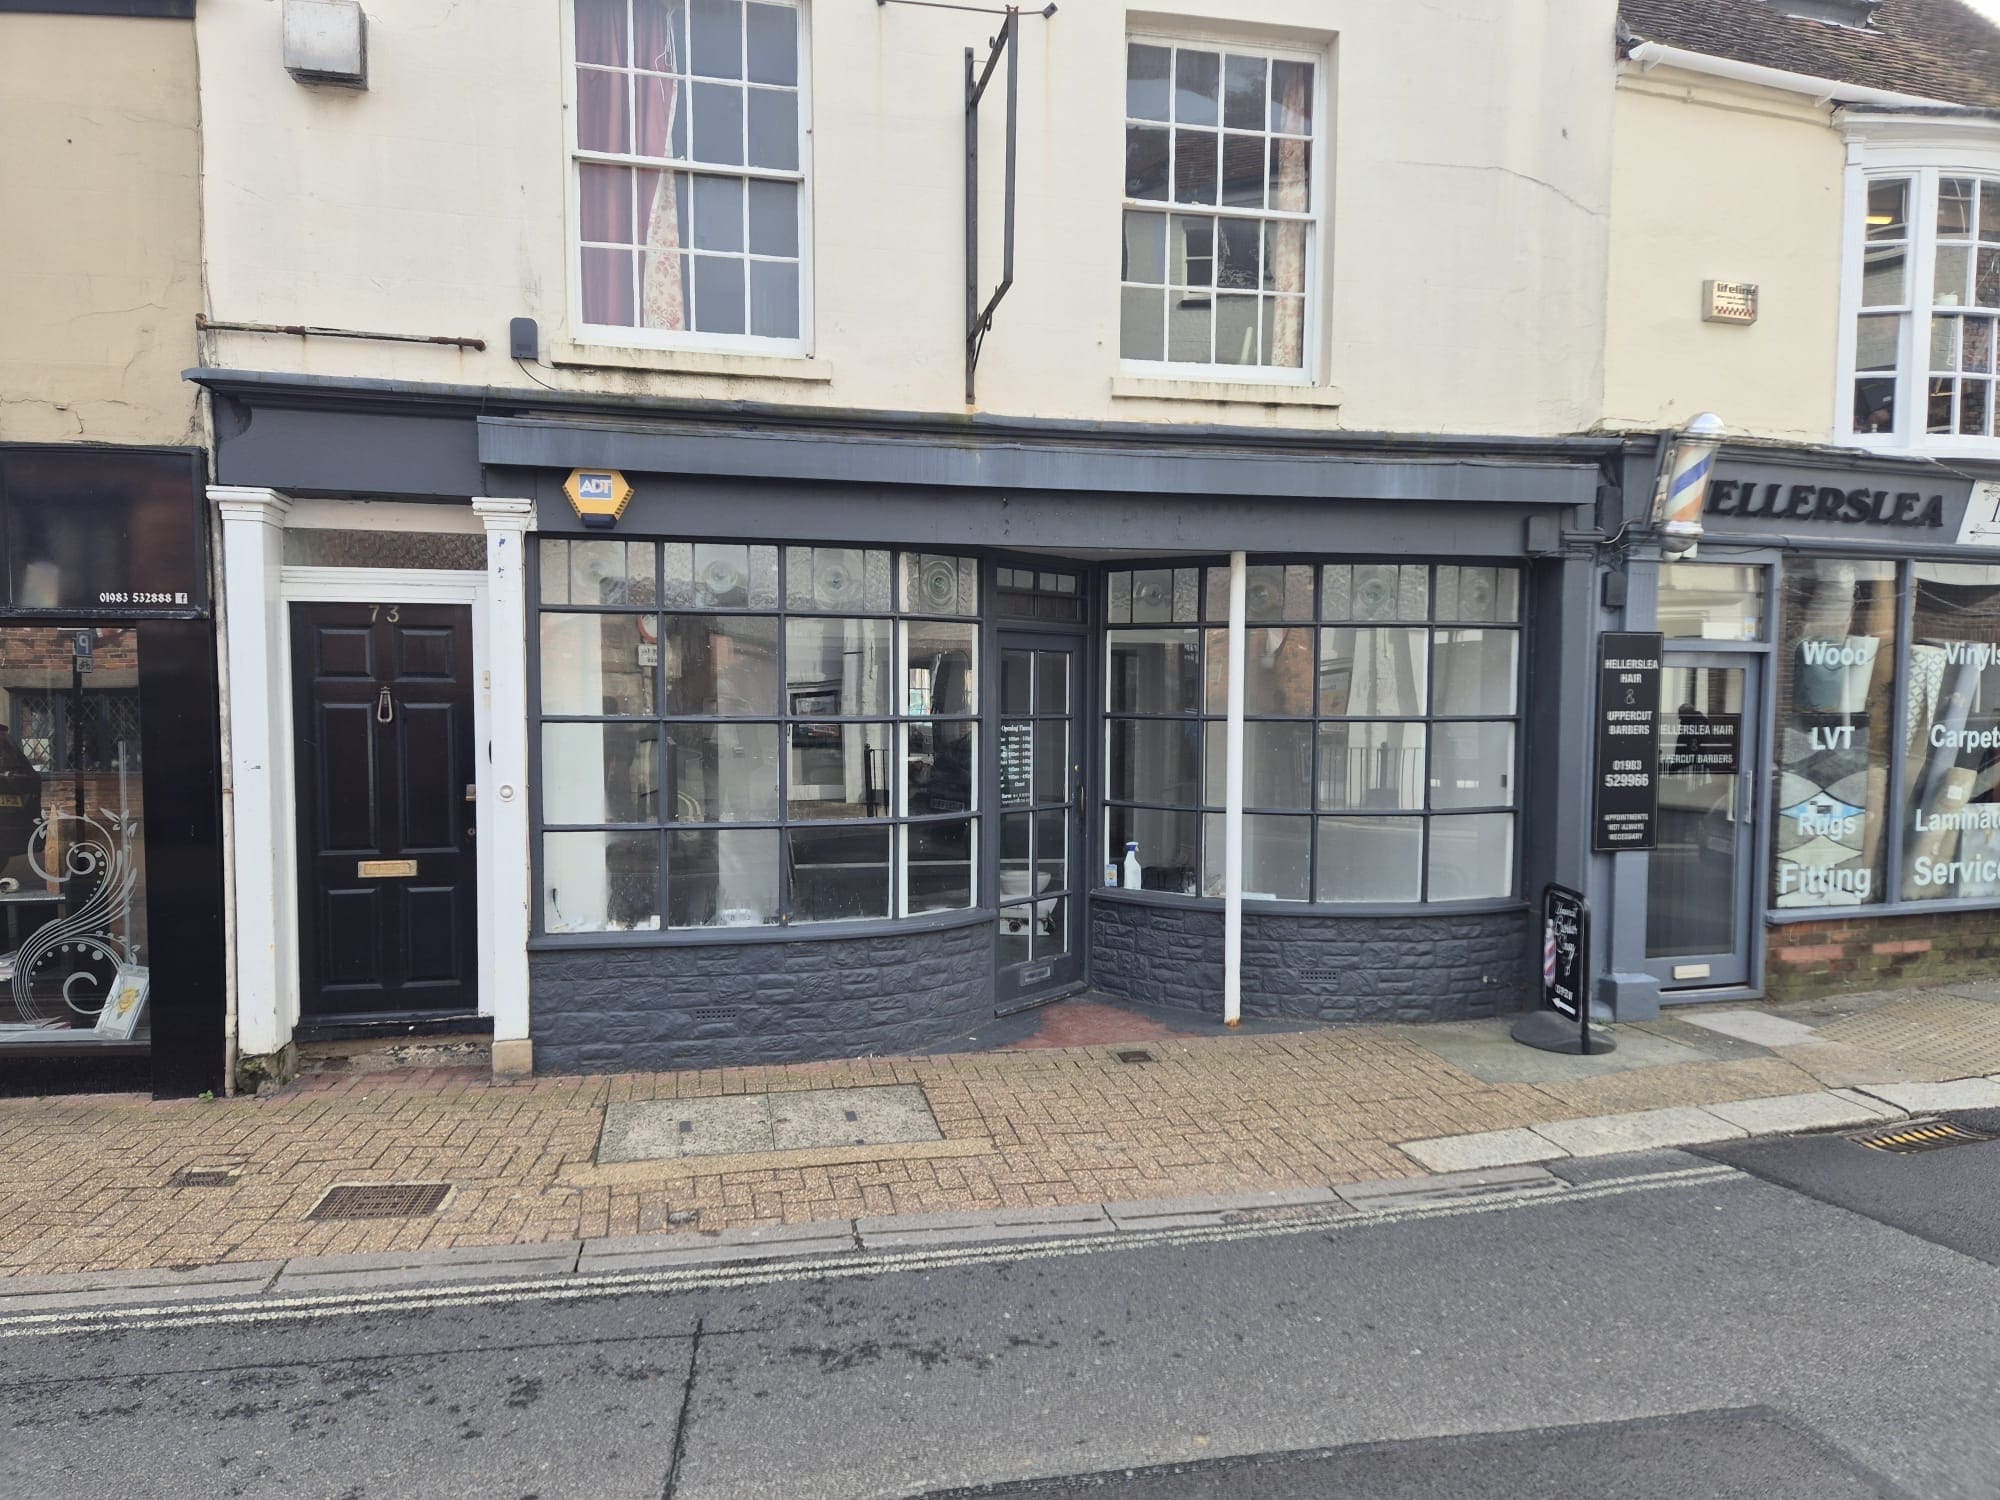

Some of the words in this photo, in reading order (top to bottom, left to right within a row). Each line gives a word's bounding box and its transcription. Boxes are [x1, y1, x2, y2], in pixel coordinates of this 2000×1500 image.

[1717, 283, 1757, 296] lifeline
[580, 478, 612, 494] ADT
[1703, 479, 1944, 528] ELLERSLEA
[99, 592, 128, 603] 01983
[132, 592, 172, 603] 532888
[369, 604, 400, 622] 73
[1803, 641, 1870, 666] Wood
[1604, 658, 1659, 669] HELLERSLEA
[1620, 673, 1642, 684] HAIR
[1625, 688, 1636, 705] &
[1607, 711, 1653, 721] UPPERCUT
[1608, 724, 1650, 735] BARBERS
[1713, 724, 1734, 735] HAIR
[1811, 726, 1855, 750] LVT
[1930, 724, 2000, 753] Carpet
[1613, 759, 1643, 771] 01983
[1697, 754, 1733, 764] BARBERS
[1604, 773, 1650, 787] 529966
[1798, 812, 1857, 840] Rugs
[1915, 808, 2000, 833] Laminat
[1913, 853, 2000, 886] Servic
[1780, 862, 1872, 898] Fitting
[1555, 984, 1574, 1000] OPEN
